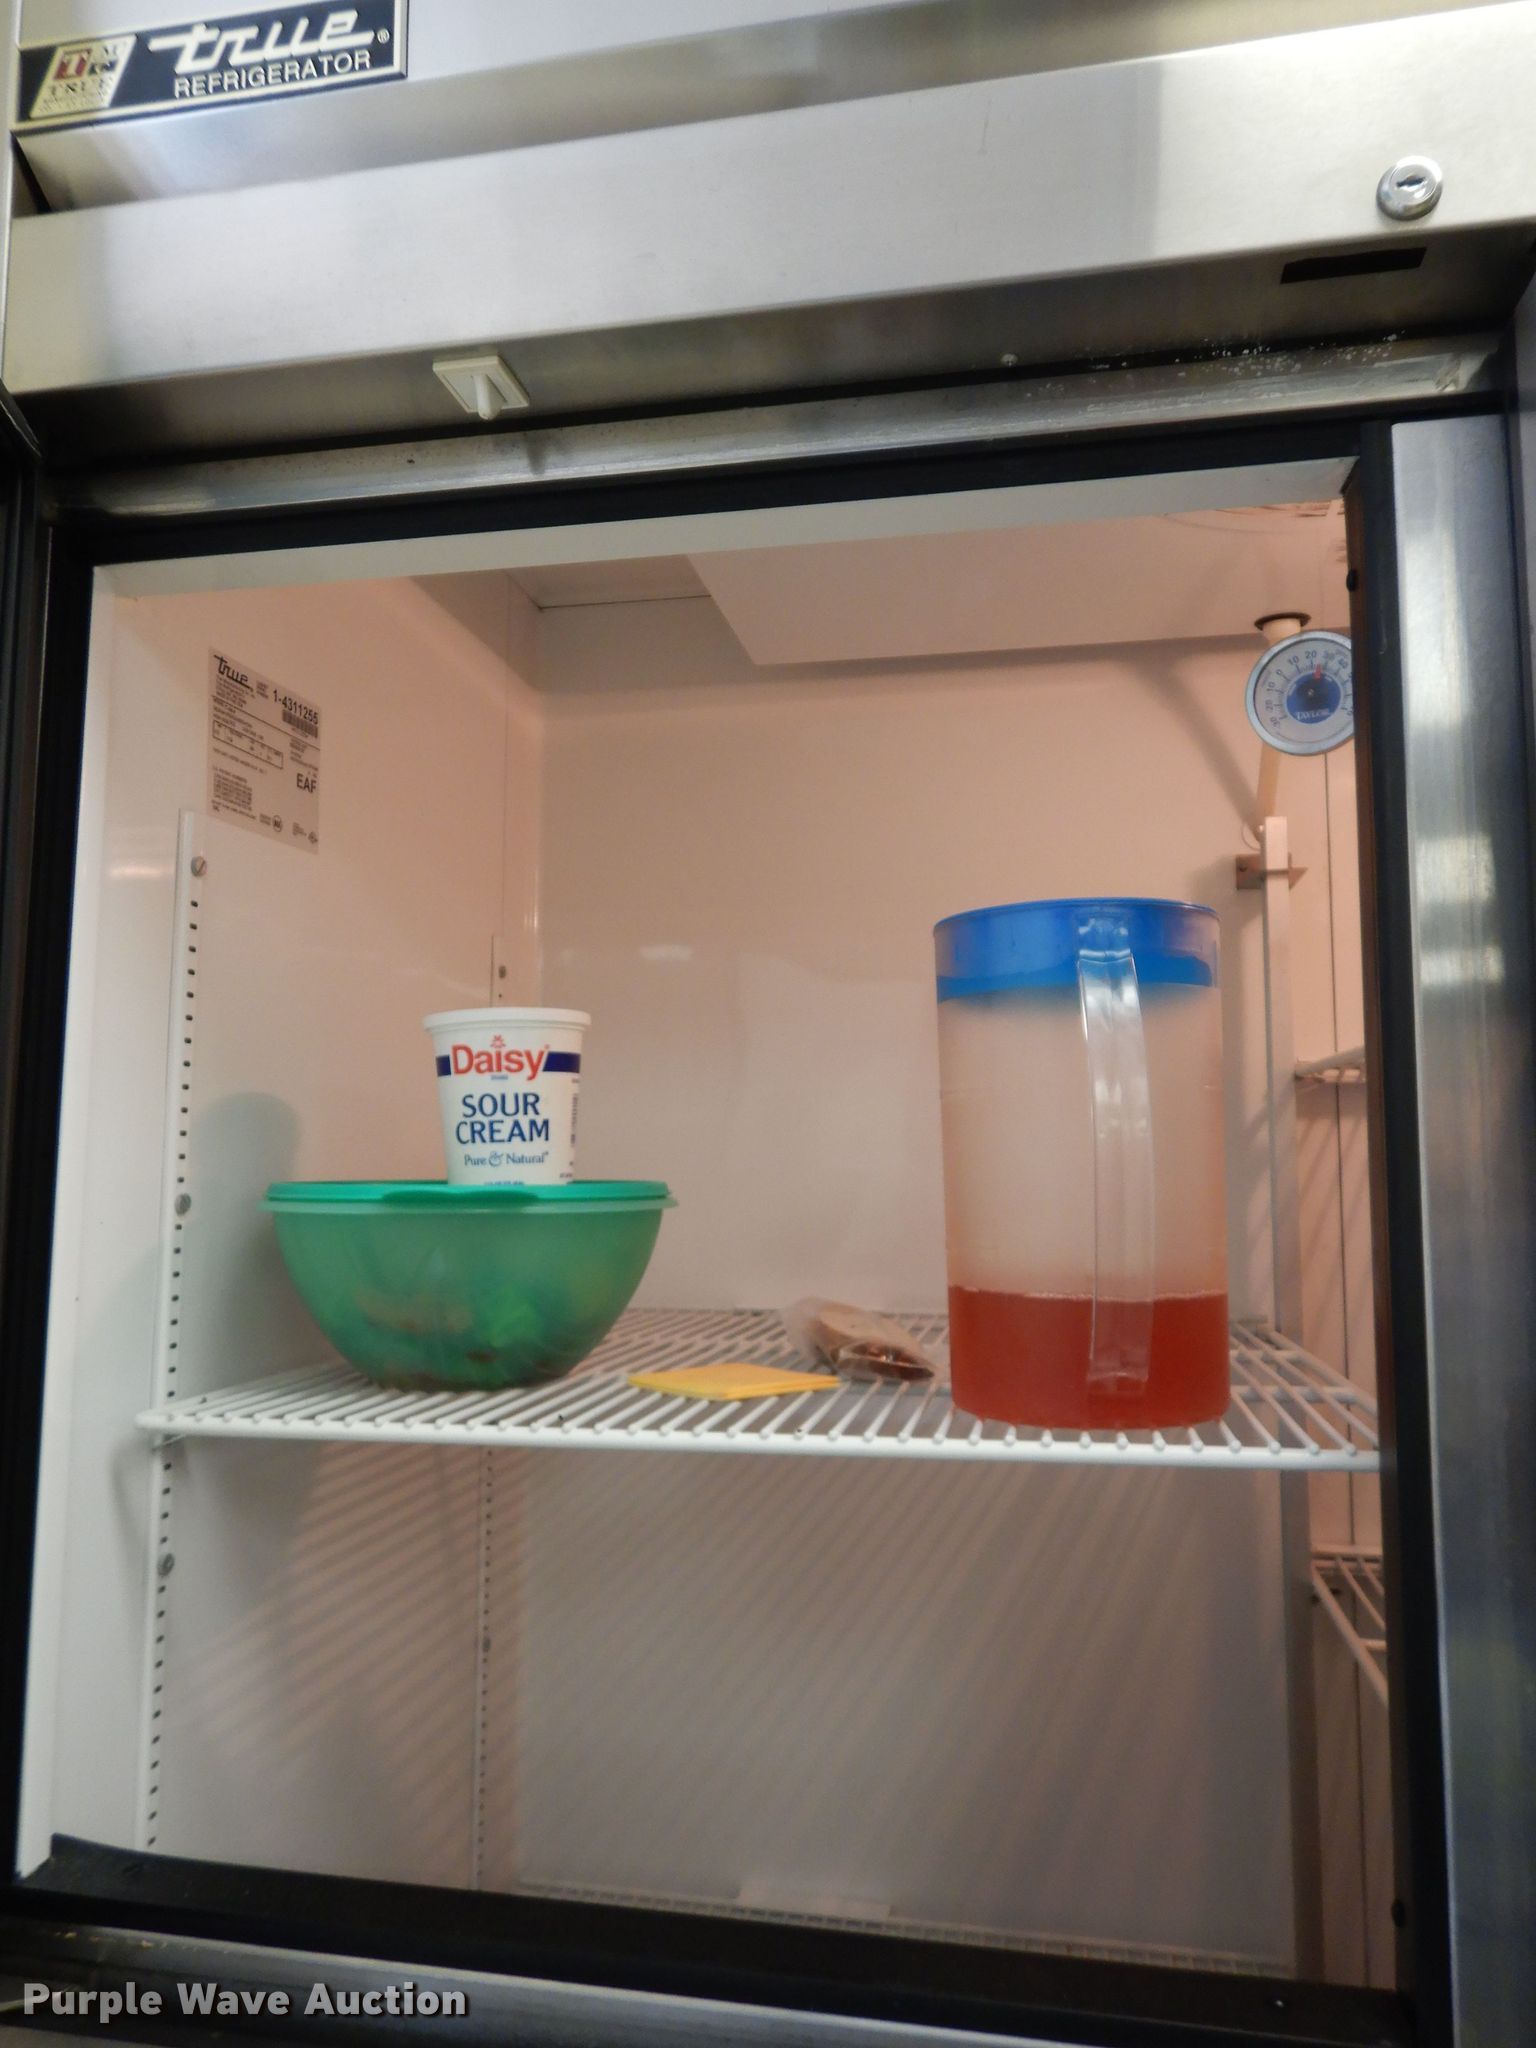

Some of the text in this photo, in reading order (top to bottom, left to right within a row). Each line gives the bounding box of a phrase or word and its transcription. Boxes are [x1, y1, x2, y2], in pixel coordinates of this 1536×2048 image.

[174, 49, 372, 99] REFRIGERATOR
[273, 688, 319, 725] 1-4311255
[296, 772, 317, 793] EAF
[451, 1043, 545, 1081] Daisy
[461, 1092, 541, 1118] SOUR
[455, 1118, 550, 1145] CREAM
[464, 1153, 487, 1167] Pure
[488, 1150, 504, 1168] &
